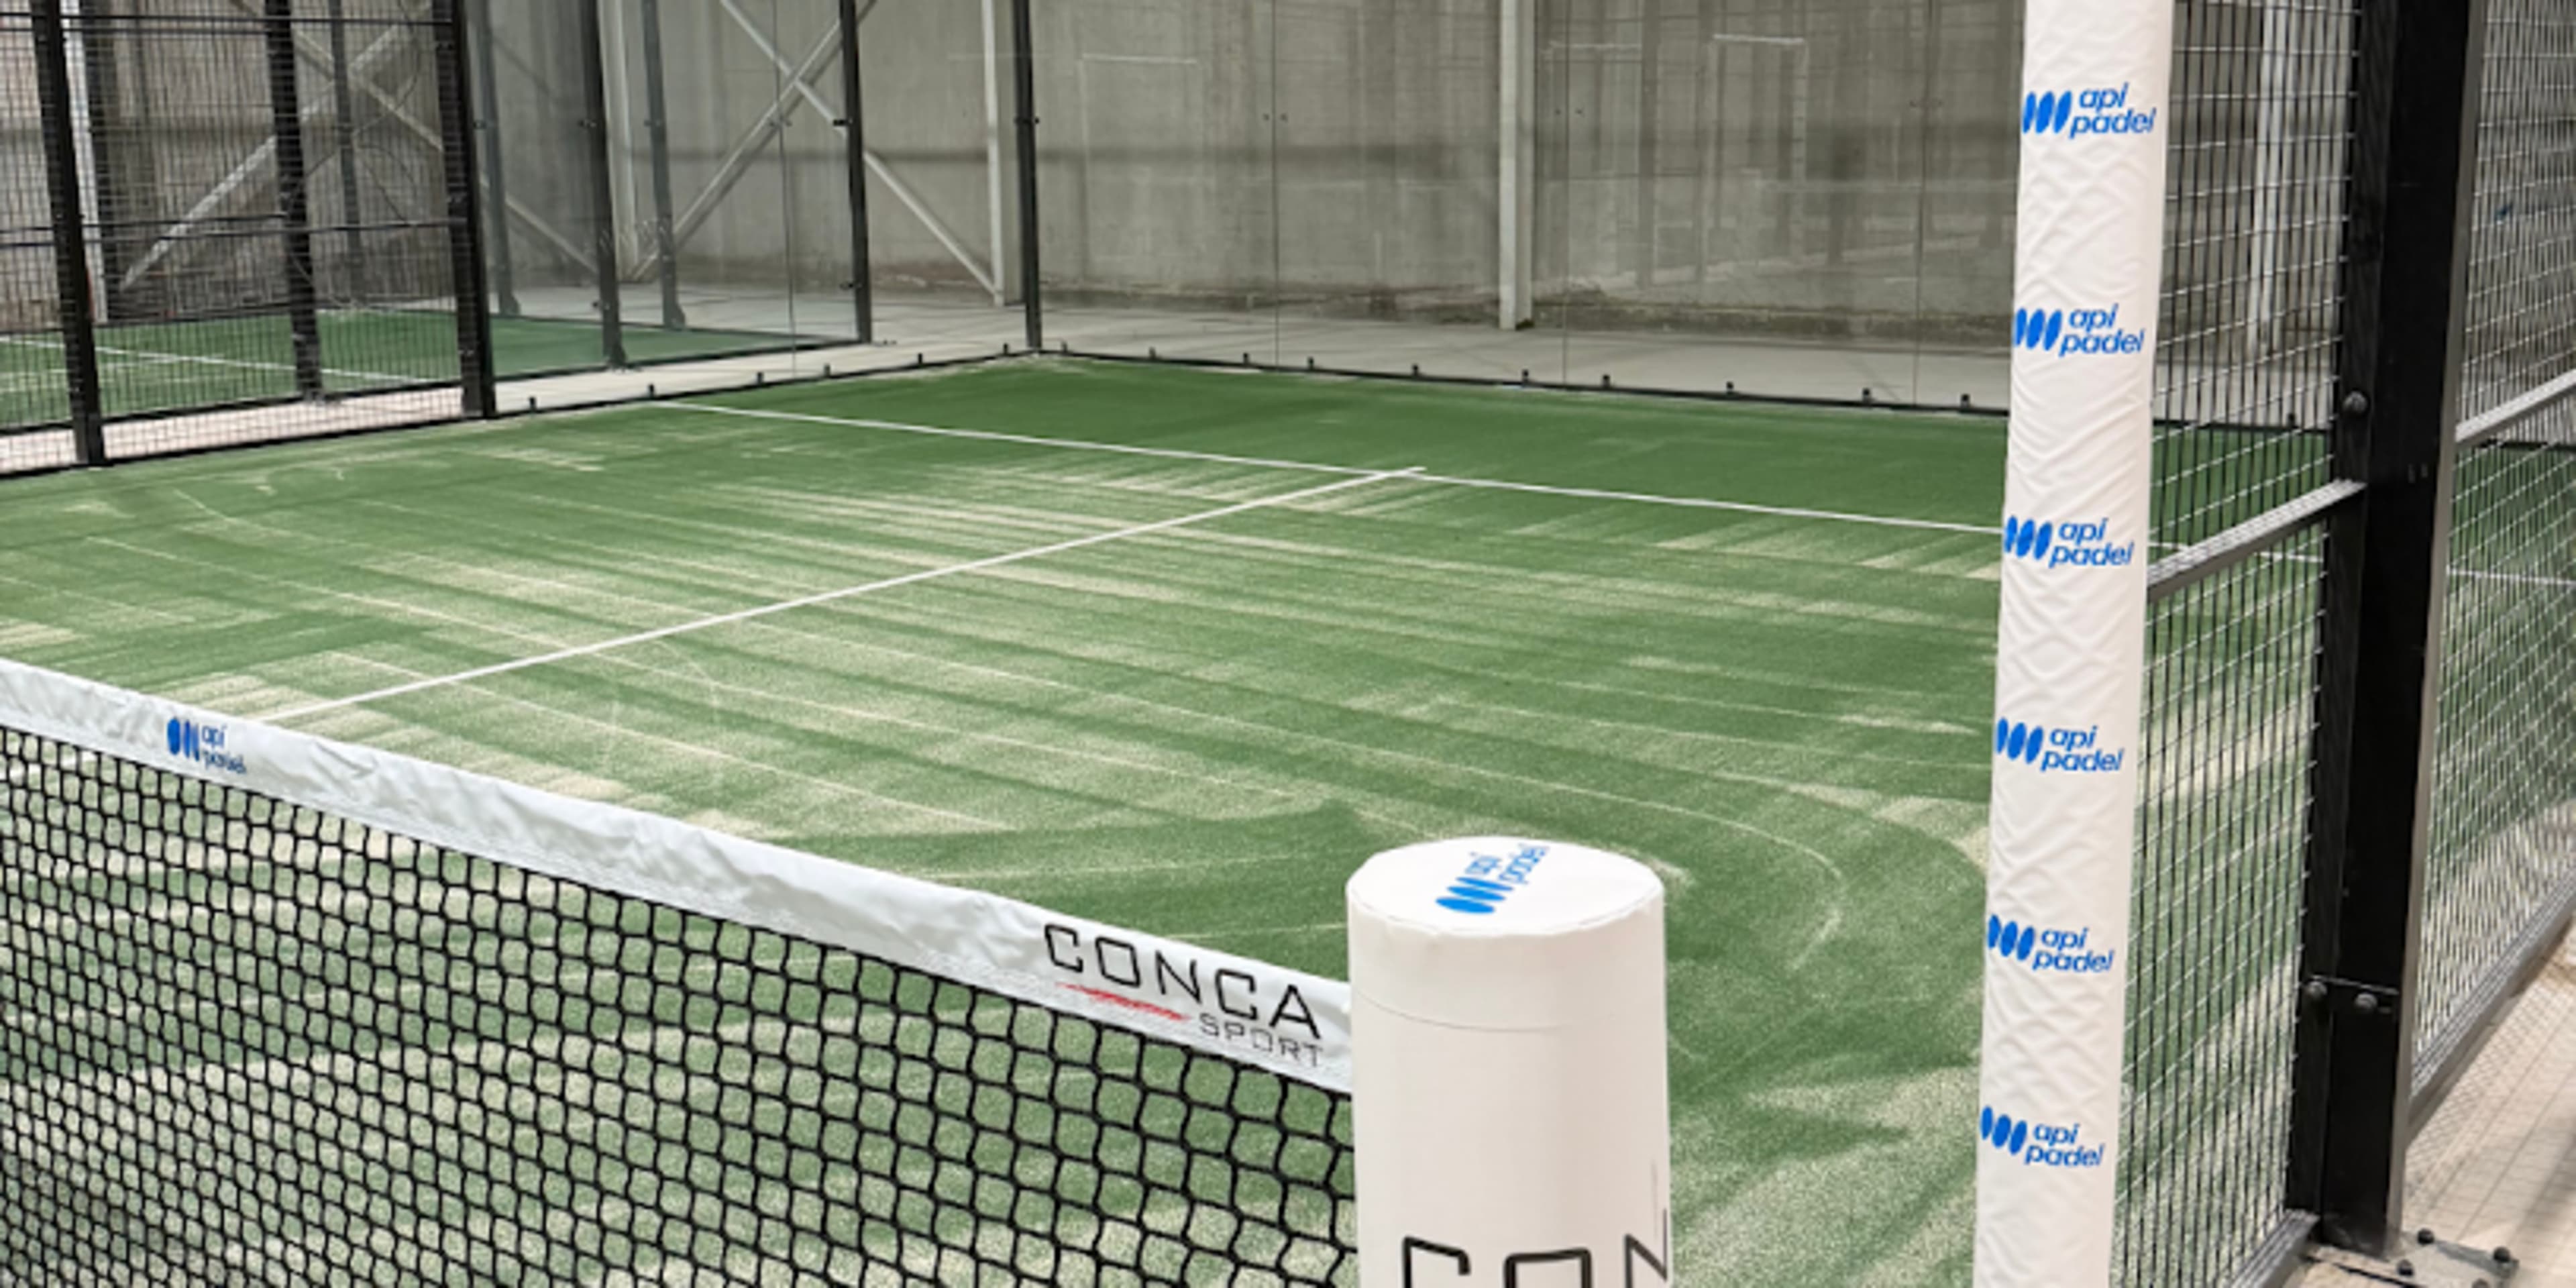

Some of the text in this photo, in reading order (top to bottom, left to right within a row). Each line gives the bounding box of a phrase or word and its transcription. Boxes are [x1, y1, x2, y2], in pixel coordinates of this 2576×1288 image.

[2078, 82, 2130, 113] api
[2069, 108, 2157, 139] padel
[2068, 303, 2118, 333] api
[2059, 328, 2145, 357] padel
[2058, 518, 2109, 546] api
[2049, 541, 2135, 569] padel
[202, 723, 227, 749] api
[2049, 725, 2098, 752] api
[2040, 747, 2125, 772] padel
[2041, 927, 2089, 951] api
[2032, 949, 2115, 973] padel
[1044, 923, 1322, 1039] CONCA
[1199, 1012, 1324, 1067] SPORT
[2033, 1123, 2080, 1147] api
[2024, 1143, 2106, 1168] padel
